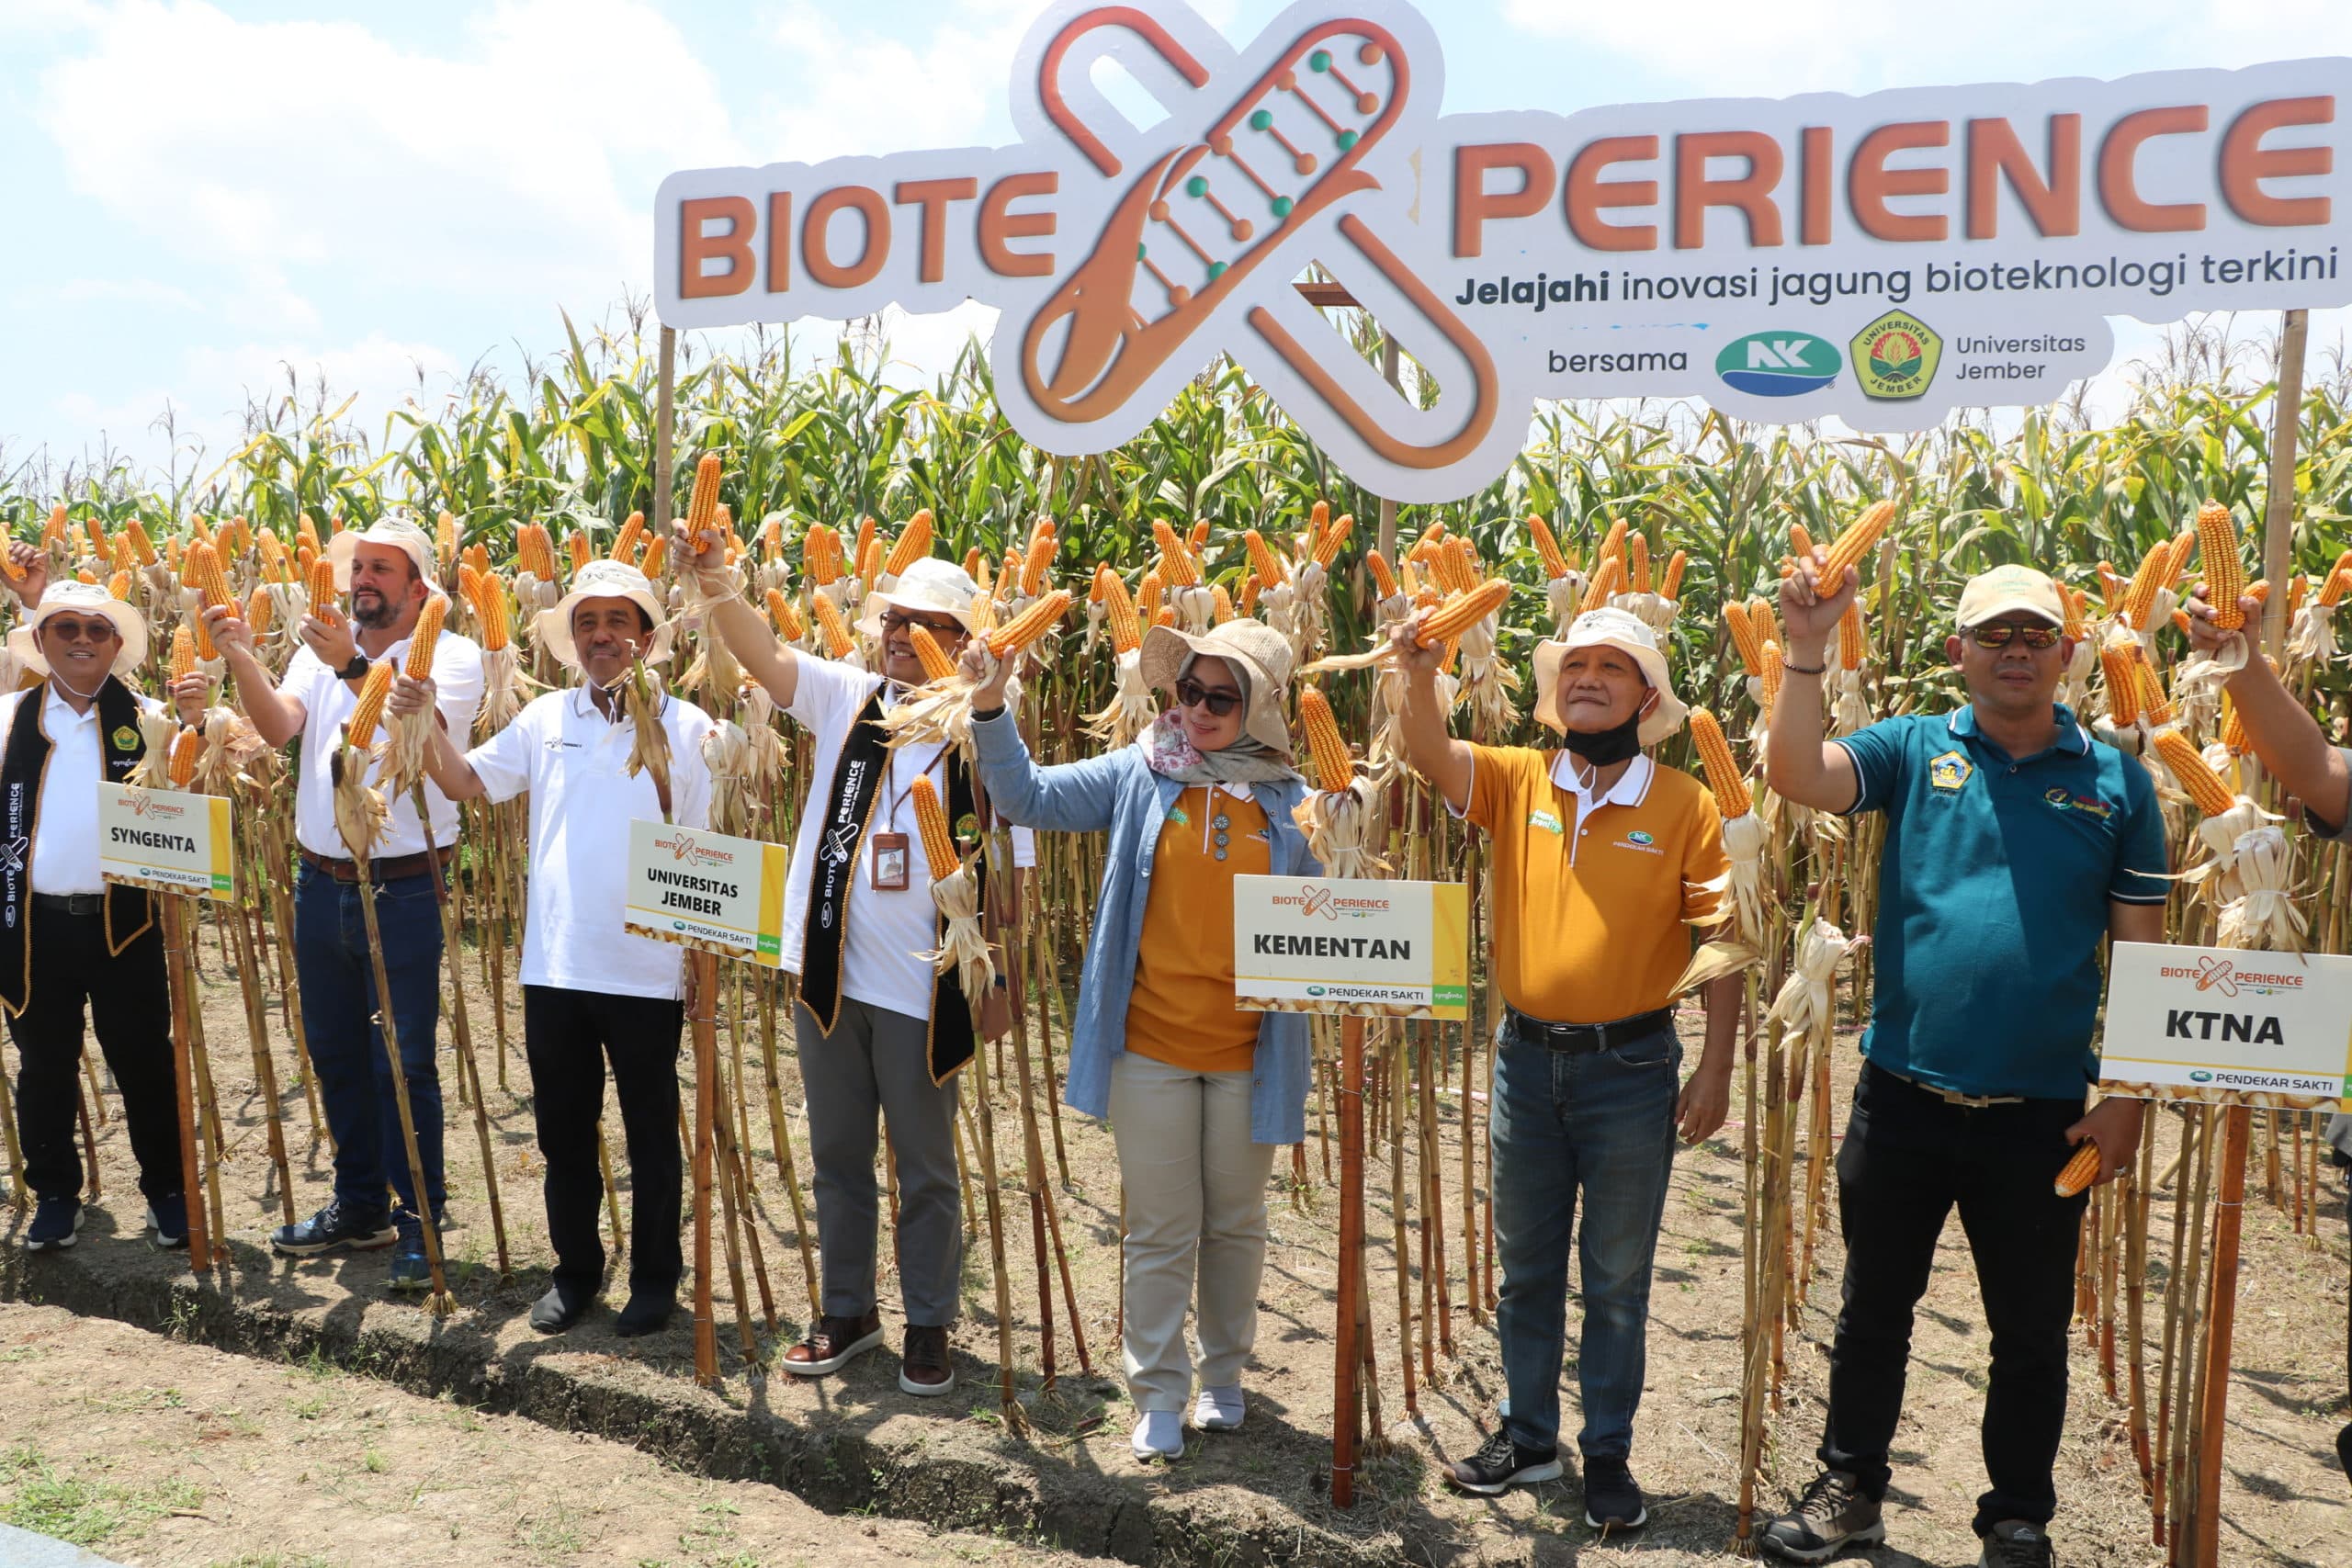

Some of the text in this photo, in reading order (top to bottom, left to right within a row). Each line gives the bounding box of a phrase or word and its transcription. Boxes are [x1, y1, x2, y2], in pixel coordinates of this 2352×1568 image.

[1455, 246, 2337, 312] Jelajahi inovasi jagung bioteknologi terkini
[1863, 321, 1930, 346] UNIVERSITAS
[1956, 334, 2086, 354] Universitas
[1548, 350, 1688, 373] bersama
[1747, 340, 1813, 368] NK
[1956, 362, 2046, 379] Jember
[1870, 376, 1923, 393] JEMBER
[111, 827, 196, 853] SYNGENTA
[152, 870, 187, 881] PENDEKAR
[648, 868, 738, 898] UNIVERSITAS
[662, 891, 721, 916] JEMBER
[687, 924, 729, 941] PENDEKAR
[729, 933, 752, 945] SAKTI
[1254, 934, 1410, 960] KEMENTAN
[1329, 987, 1388, 999] PENDEKAR
[1391, 990, 1424, 1000] SAKTI
[2166, 1010, 2284, 1045] KTNA
[2216, 1073, 2289, 1088] PENDEKAR
[2292, 1079, 2333, 1091] SAKTI
